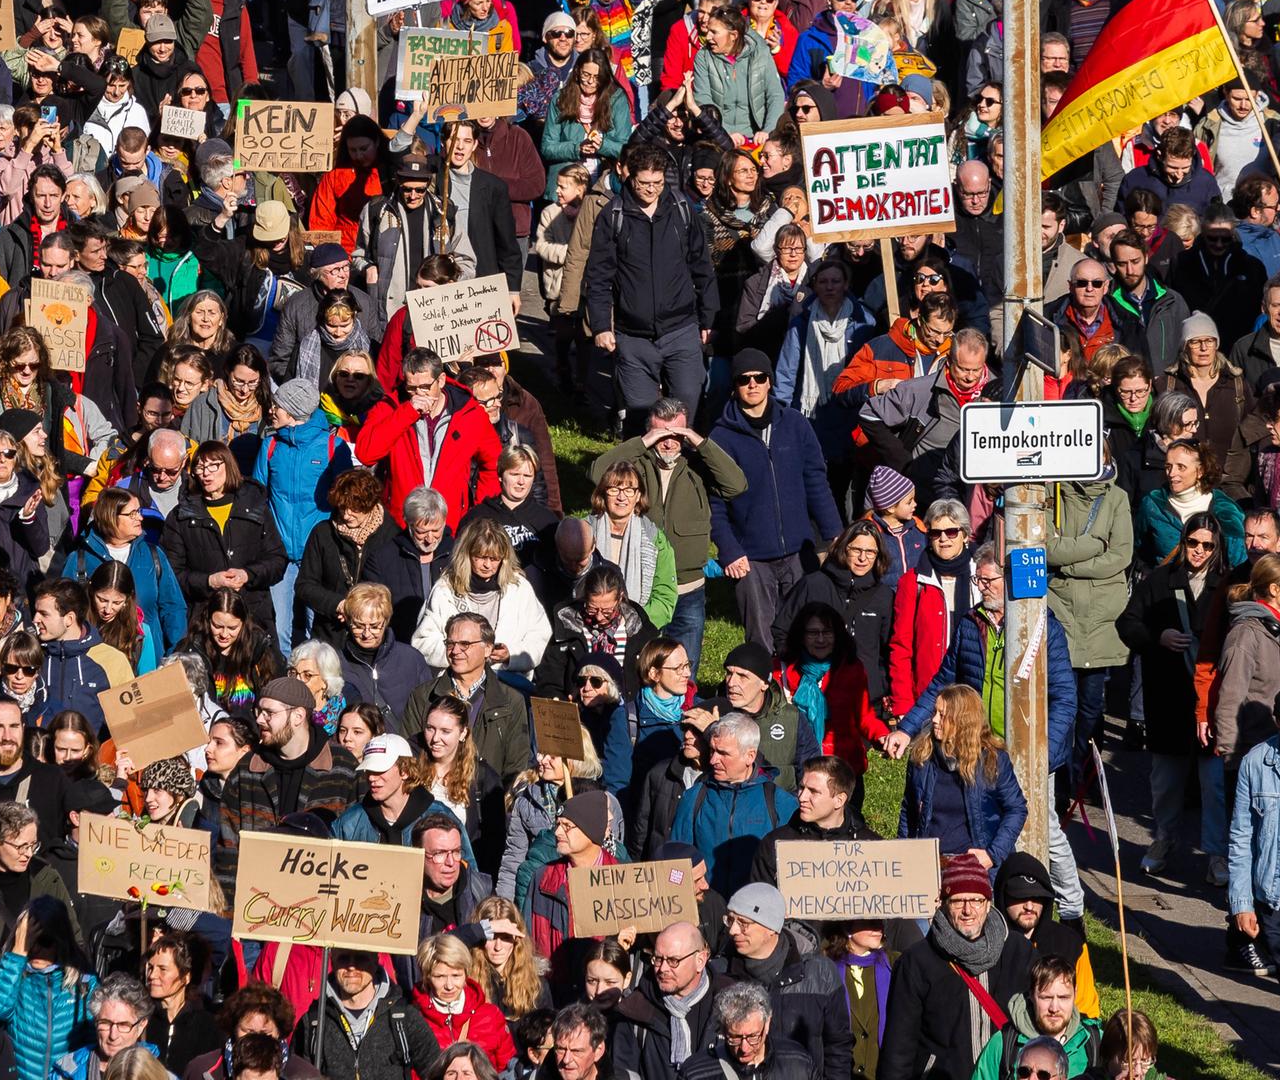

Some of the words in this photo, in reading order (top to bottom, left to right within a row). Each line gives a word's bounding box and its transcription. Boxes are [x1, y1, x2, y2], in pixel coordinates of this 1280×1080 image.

[243, 134, 315, 150] BOCK
[812, 134, 945, 177] ATTENTAT
[857, 172, 886, 189] DIE
[817, 187, 950, 225] DEMOKRATIE!
[414, 296, 435, 309] Wer
[451, 316, 482, 329] Diktatur
[427, 334, 461, 358] NEIN
[57, 350, 85, 369] AFD
[971, 430, 1094, 453] Tempokontrolle
[88, 823, 130, 849] NIE
[140, 829, 208, 863] WIEDER
[129, 862, 204, 886] RECHTS
[280, 848, 369, 881] Höcke
[786, 860, 902, 879] DEMOKRATIE
[590, 869, 625, 887] NEIN
[835, 880, 868, 893] UND
[593, 895, 683, 922] RASSISMUS
[789, 894, 929, 915] MENSCHENRECHTE
[243, 892, 326, 941] Curry
[330, 898, 402, 939] Wurst
